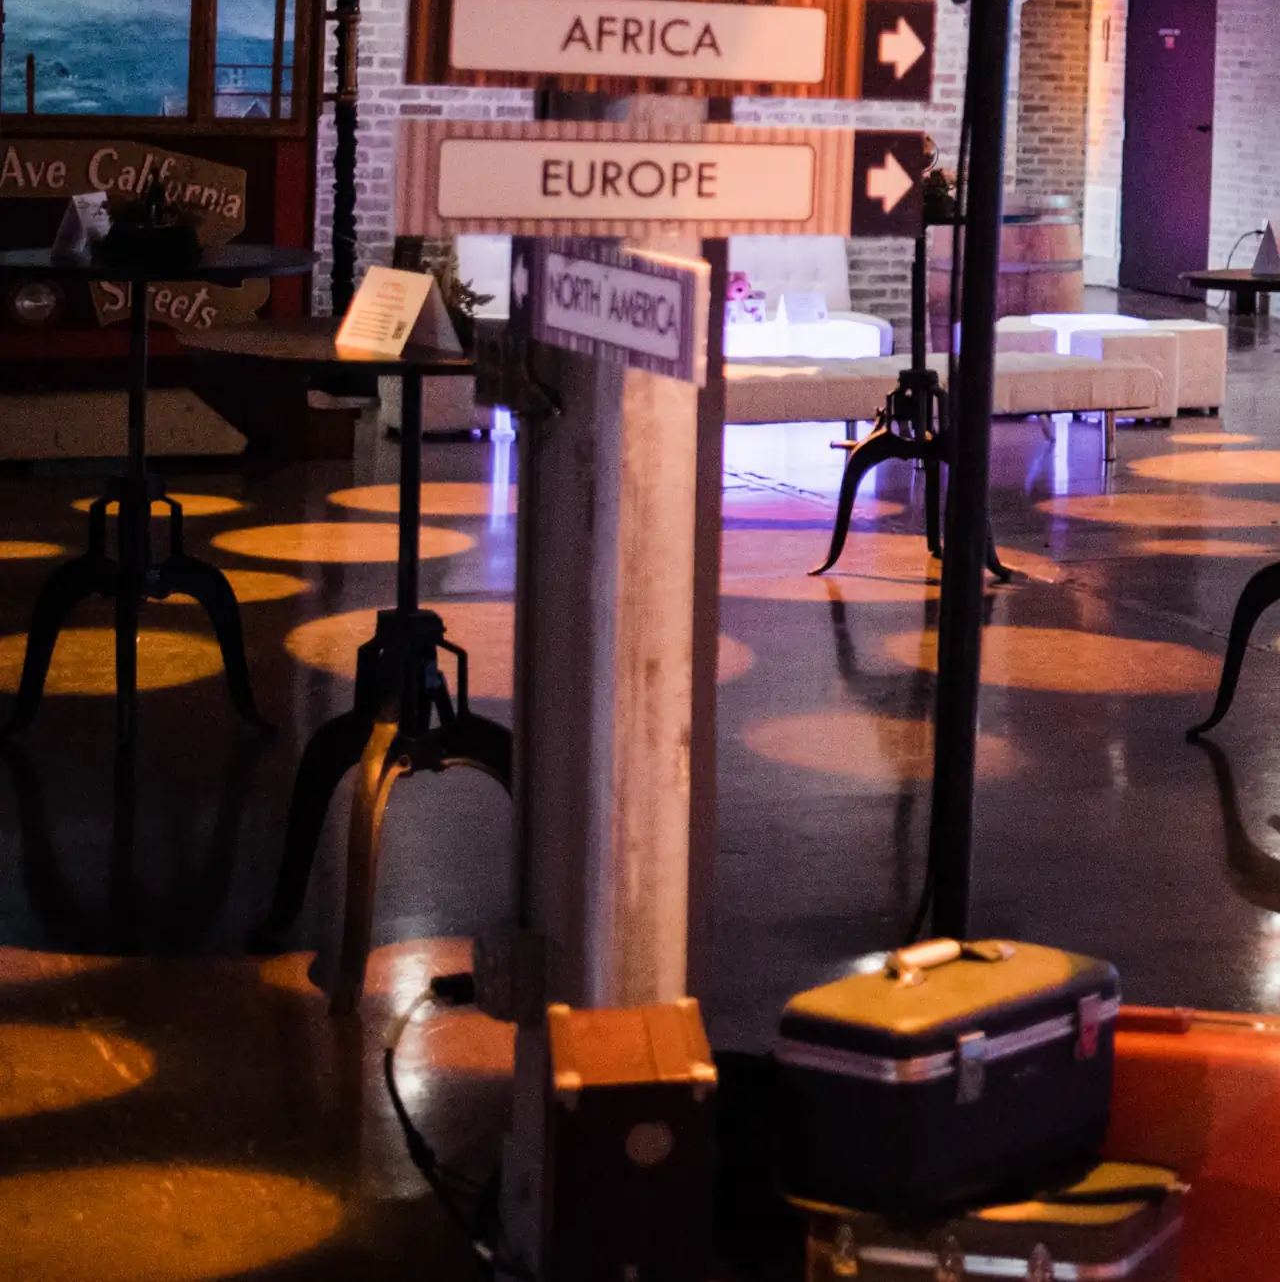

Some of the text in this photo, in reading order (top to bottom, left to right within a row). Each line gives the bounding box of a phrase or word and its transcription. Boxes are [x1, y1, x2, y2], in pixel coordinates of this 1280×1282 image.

[561, 16, 721, 57] AFRICA
[0, 145, 66, 188] Ave
[541, 159, 716, 198] EUROPE
[100, 281, 218, 329] Seets
[549, 272, 680, 341] NORTH AMERICA
